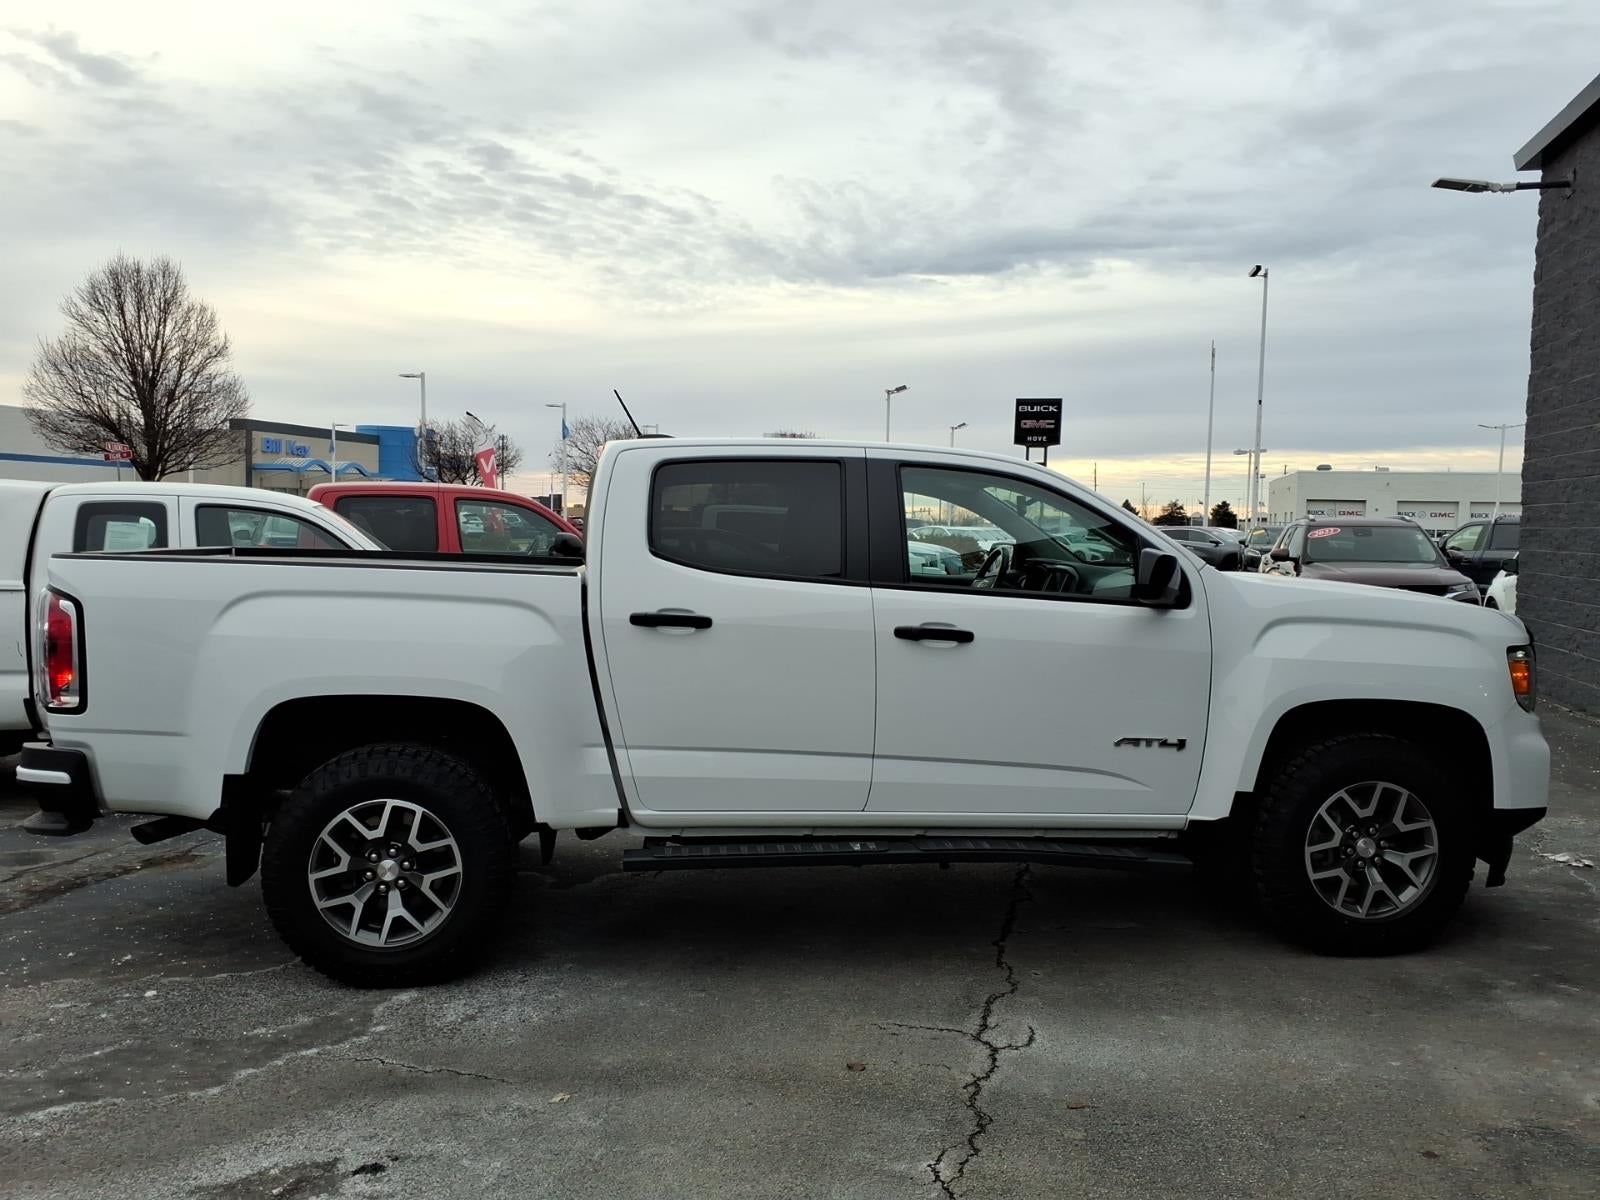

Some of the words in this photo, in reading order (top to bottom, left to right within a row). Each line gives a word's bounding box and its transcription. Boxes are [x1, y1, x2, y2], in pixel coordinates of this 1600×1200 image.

[1020, 419, 1056, 429] GMC
[262, 437, 281, 453] Bill
[1113, 737, 1188, 751] AT4
